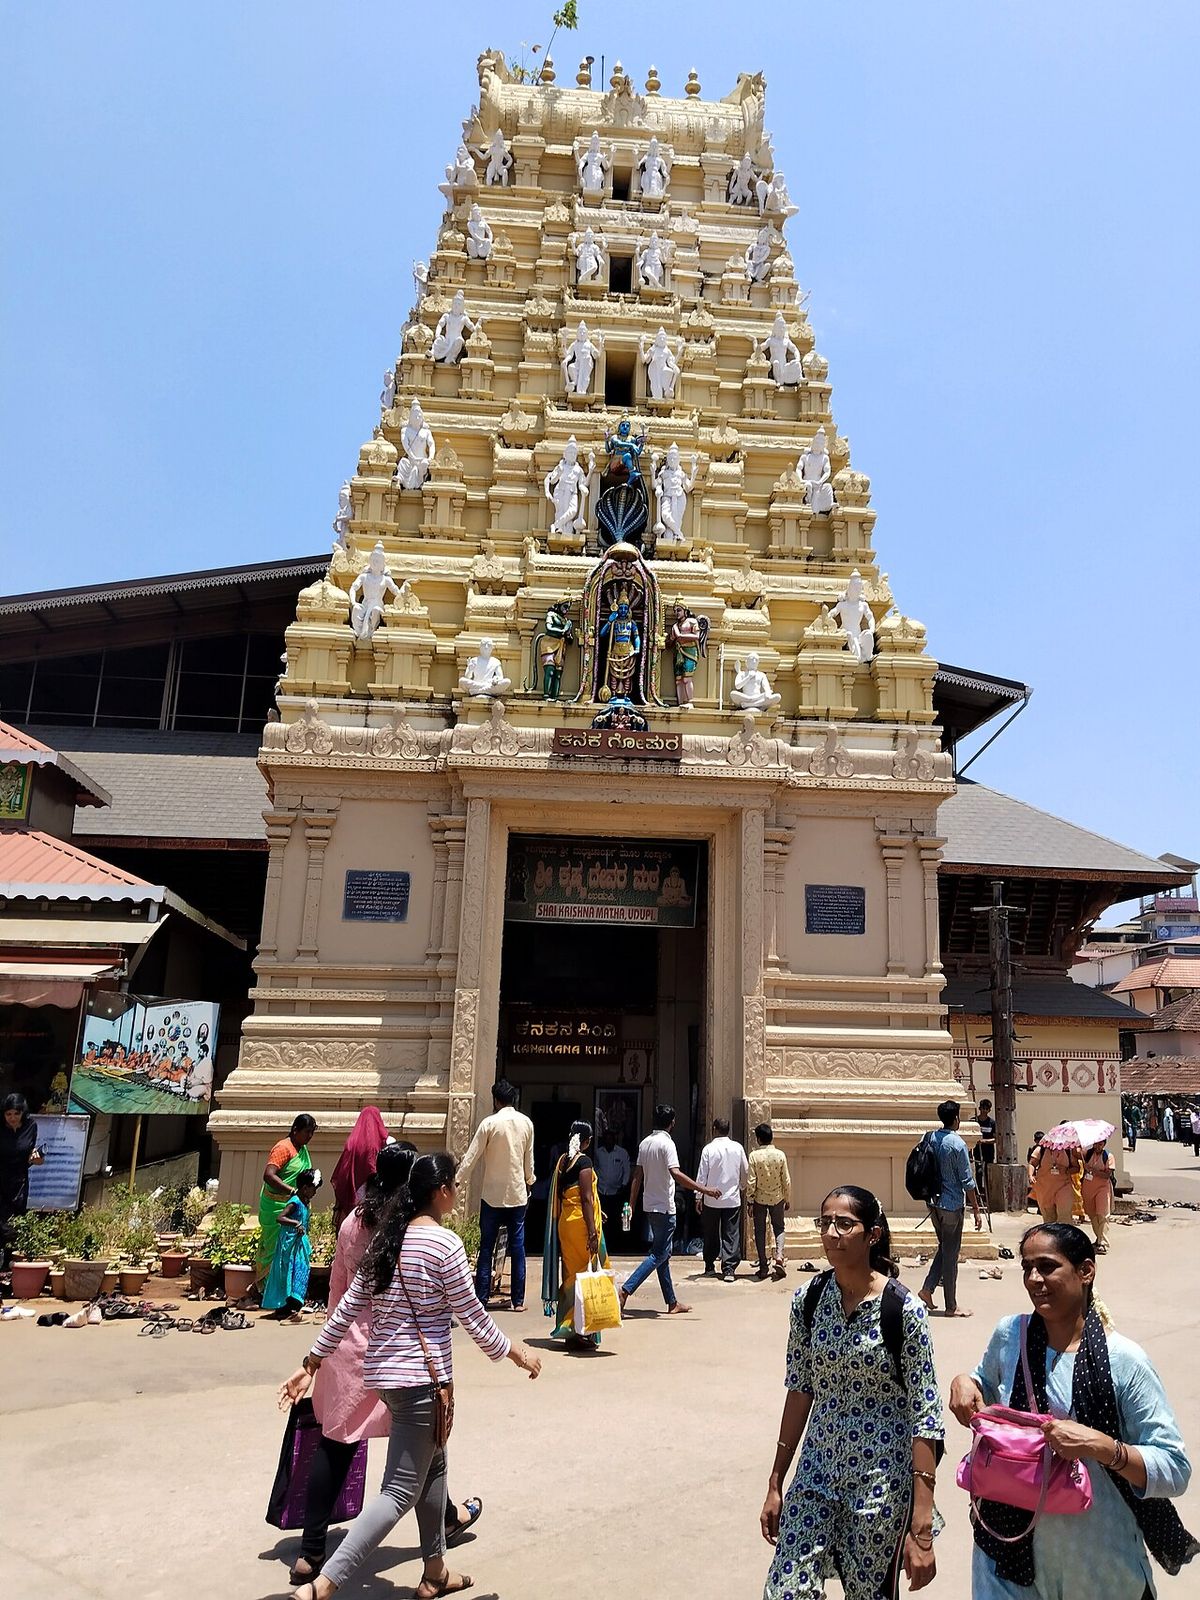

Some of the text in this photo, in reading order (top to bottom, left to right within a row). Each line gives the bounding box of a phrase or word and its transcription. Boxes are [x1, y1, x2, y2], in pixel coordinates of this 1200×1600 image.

[558, 731, 679, 751] ಕನಕ ಗೋಪುರ
[558, 905, 594, 919] KRISHNA
[515, 1020, 573, 1036] ಕನಕನ
[512, 1044, 580, 1055] KANAKANA
